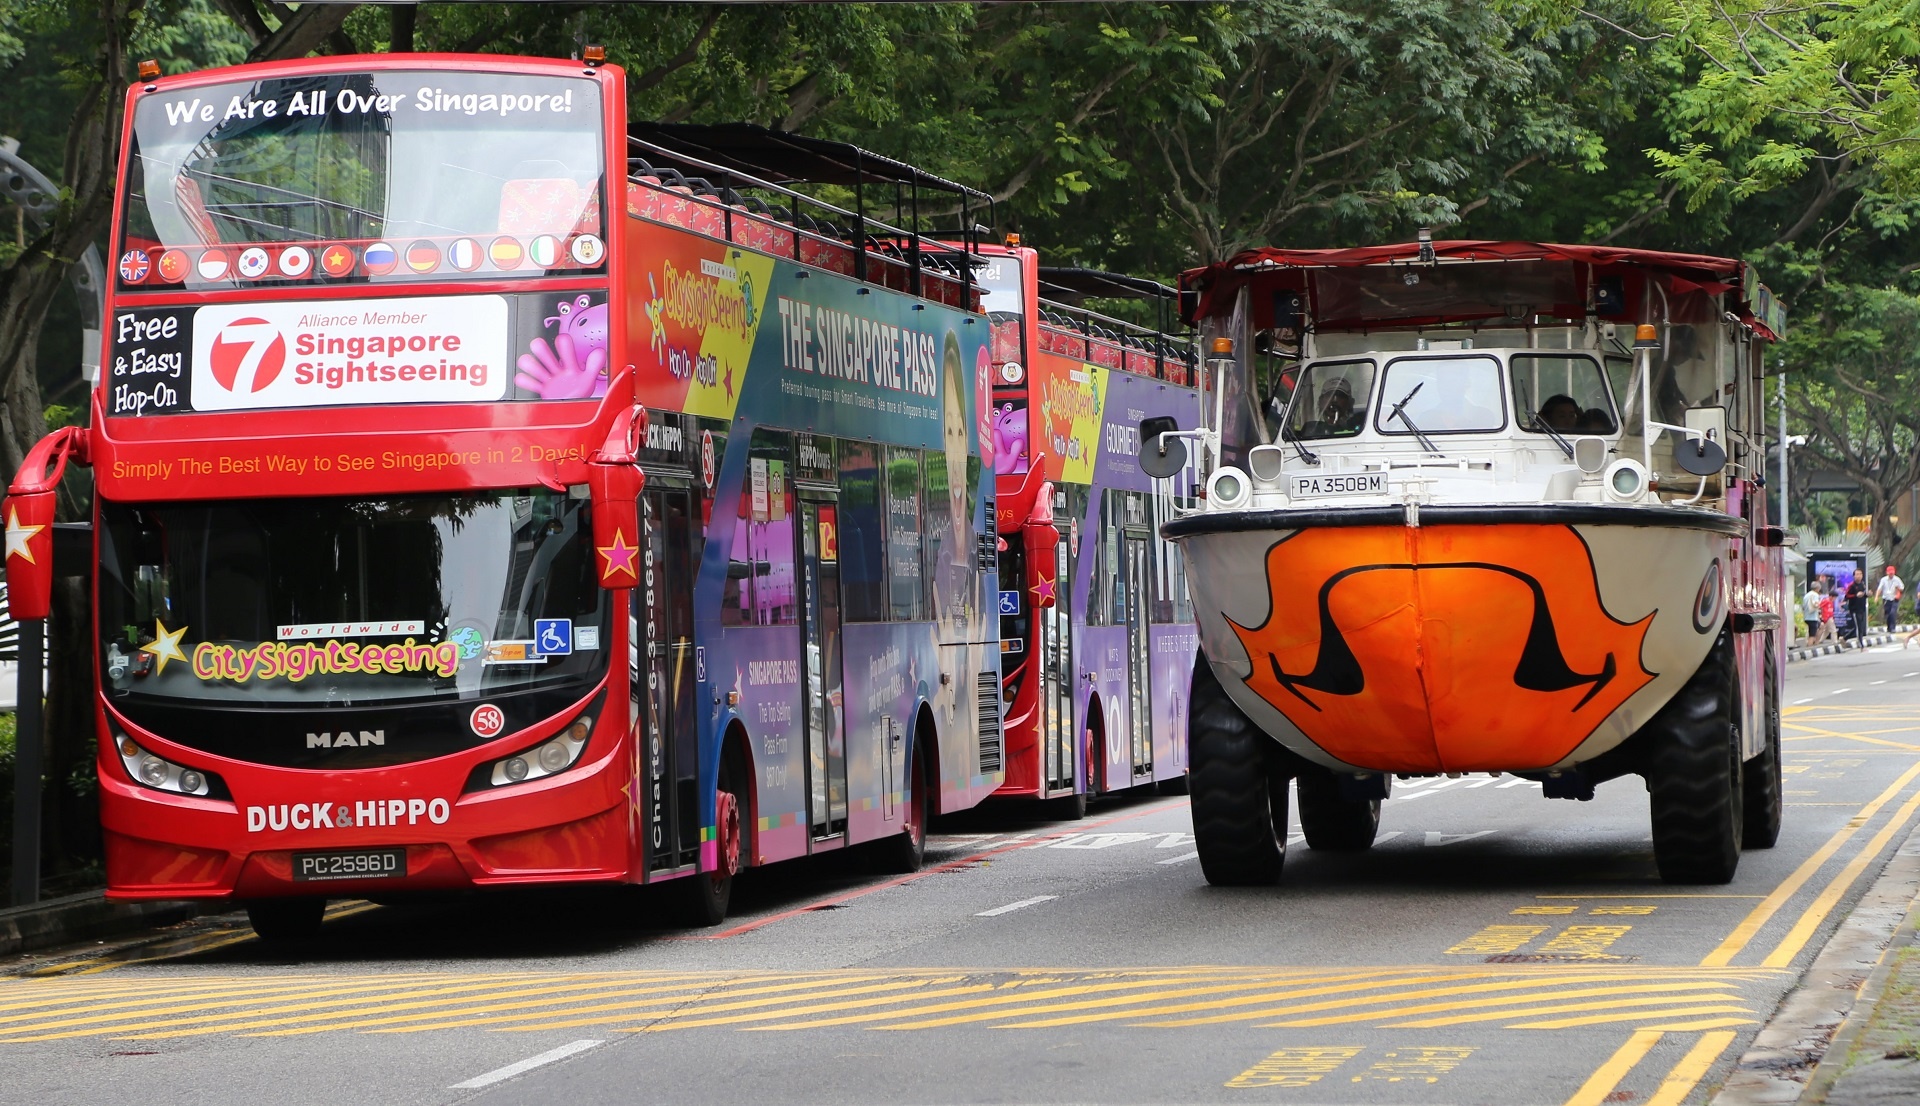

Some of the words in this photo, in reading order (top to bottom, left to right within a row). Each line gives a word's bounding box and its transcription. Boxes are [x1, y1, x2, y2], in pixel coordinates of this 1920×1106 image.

[165, 98, 215, 127] We
[225, 92, 277, 120] Are
[287, 90, 325, 115] All
[337, 89, 406, 114] Over
[414, 86, 573, 117] Singapore!
[117, 313, 178, 343] Free
[297, 314, 358, 328] Alliance
[362, 312, 428, 325] Member
[295, 333, 461, 359] Singapore
[778, 296, 813, 372] THE
[816, 305, 901, 391] SINGAPORE
[902, 327, 937, 398] PASS
[114, 356, 128, 376] &
[130, 348, 182, 378] Easy
[294, 359, 488, 389] Sightseeing
[668, 347, 681, 379] Hop
[682, 349, 692, 378] On
[695, 354, 707, 389] Hop
[114, 382, 177, 417] Hop-On
[112, 459, 173, 481] Simply
[178, 457, 213, 475] The
[219, 456, 261, 474] Best
[265, 454, 308, 475] Way
[313, 455, 332, 471] to
[337, 454, 375, 470] See
[381, 450, 481, 472] Singapore
[488, 447, 504, 463] in
[511, 446, 523, 463] 2
[529, 443, 585, 466] Days!
[281, 622, 416, 637] Worldwide
[193, 637, 459, 683] CitySightseeing
[748, 661, 782, 686] SINGAPORE
[782, 660, 797, 684] PASS
[475, 711, 500, 731] 58
[758, 703, 767, 723] The
[768, 702, 776, 727] Top
[306, 730, 385, 749] MAN
[650, 722, 662, 849] Charter
